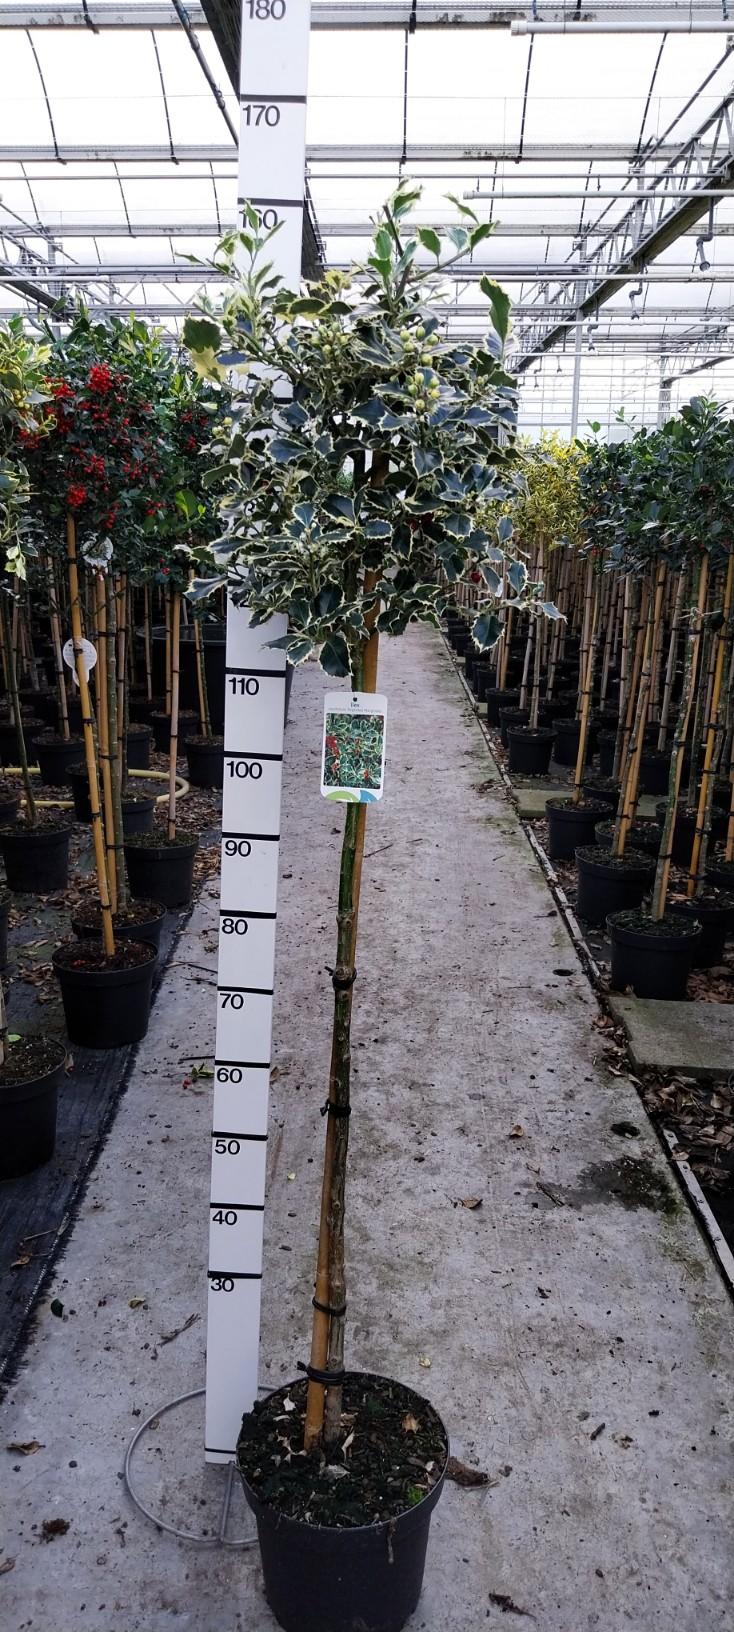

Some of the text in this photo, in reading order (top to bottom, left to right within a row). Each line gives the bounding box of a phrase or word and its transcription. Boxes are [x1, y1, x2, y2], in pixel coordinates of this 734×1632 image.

[246, 0, 286, 20] 180
[242, 105, 281, 127] 170
[228, 677, 260, 696] 110
[226, 761, 263, 779] 100
[224, 840, 252, 858] 90
[221, 918, 249, 936] 80
[219, 993, 245, 1010] 70
[216, 1068, 243, 1084] 60
[214, 1139, 241, 1156] 50
[211, 1210, 238, 1226] 40
[210, 1277, 235, 1293] 30
